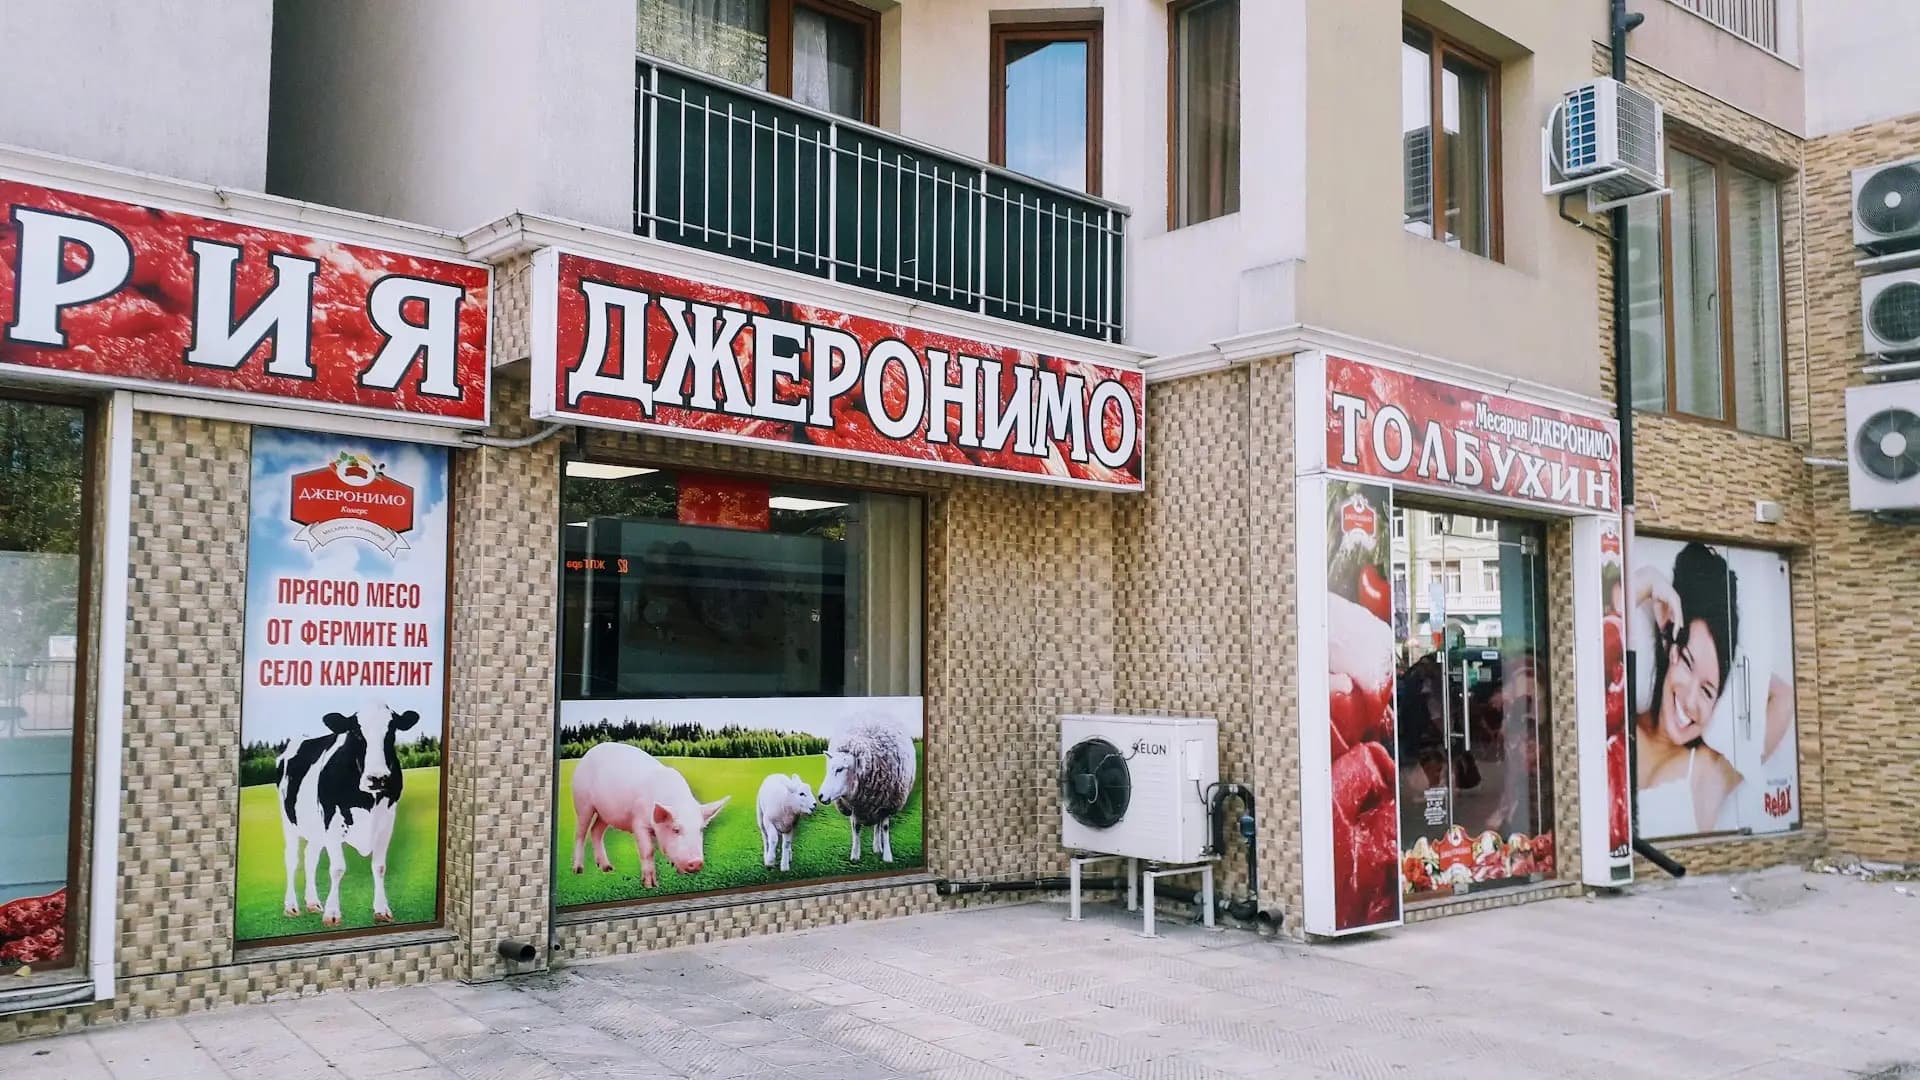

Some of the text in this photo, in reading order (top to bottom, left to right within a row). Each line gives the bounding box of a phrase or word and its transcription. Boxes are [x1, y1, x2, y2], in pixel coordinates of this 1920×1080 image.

[7, 206, 466, 399] РИЯ
[567, 280, 1138, 468] ДЖЕРОНИМО
[1332, 392, 1612, 510] ТОЛБУХИН
[1475, 402, 1613, 461] Месария ДЖЕРОНИМО
[299, 487, 405, 507] ДЖЕРОНИМО
[278, 578, 420, 609] ПРЯСНО МЕСО
[267, 618, 428, 648] ОТ ФЕРМИТЕ НА
[260, 659, 433, 687] СЕЛО КАРАПЕЛИТ
